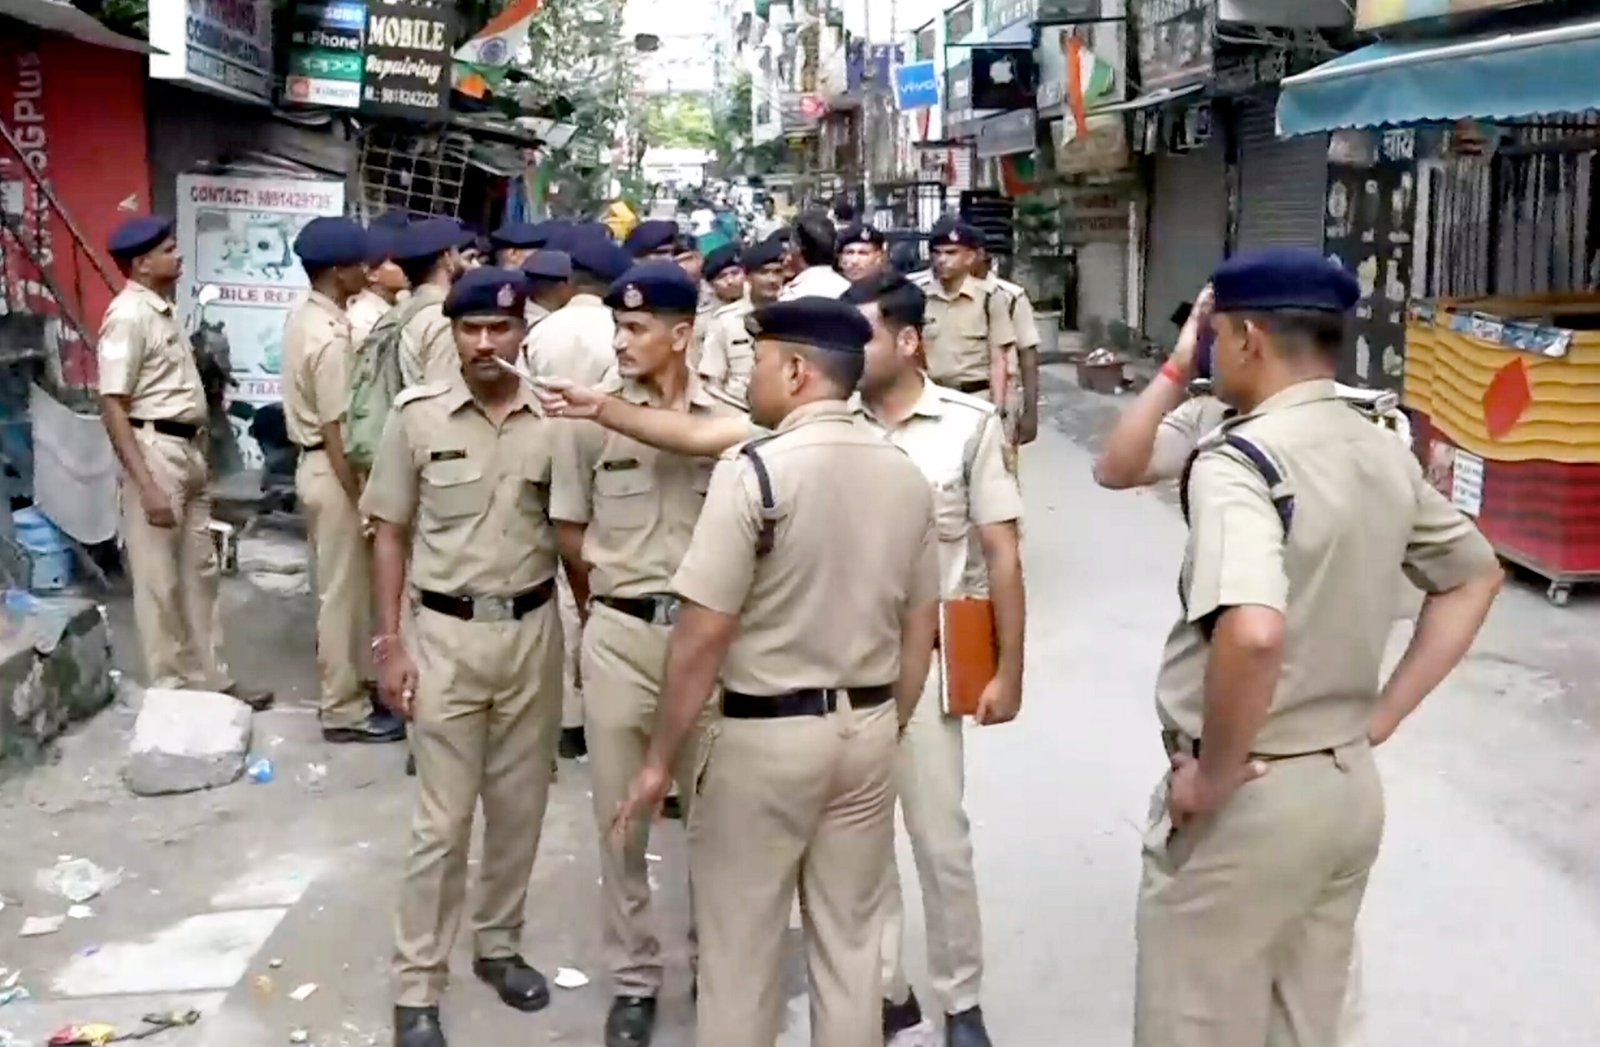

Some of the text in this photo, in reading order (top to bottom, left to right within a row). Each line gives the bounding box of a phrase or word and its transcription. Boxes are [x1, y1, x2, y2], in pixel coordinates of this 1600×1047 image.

[367, 15, 445, 51] MOBILE
[365, 54, 442, 85] Repairing
[900, 79, 935, 93] vivo
[191, 286, 257, 301] MBILE
